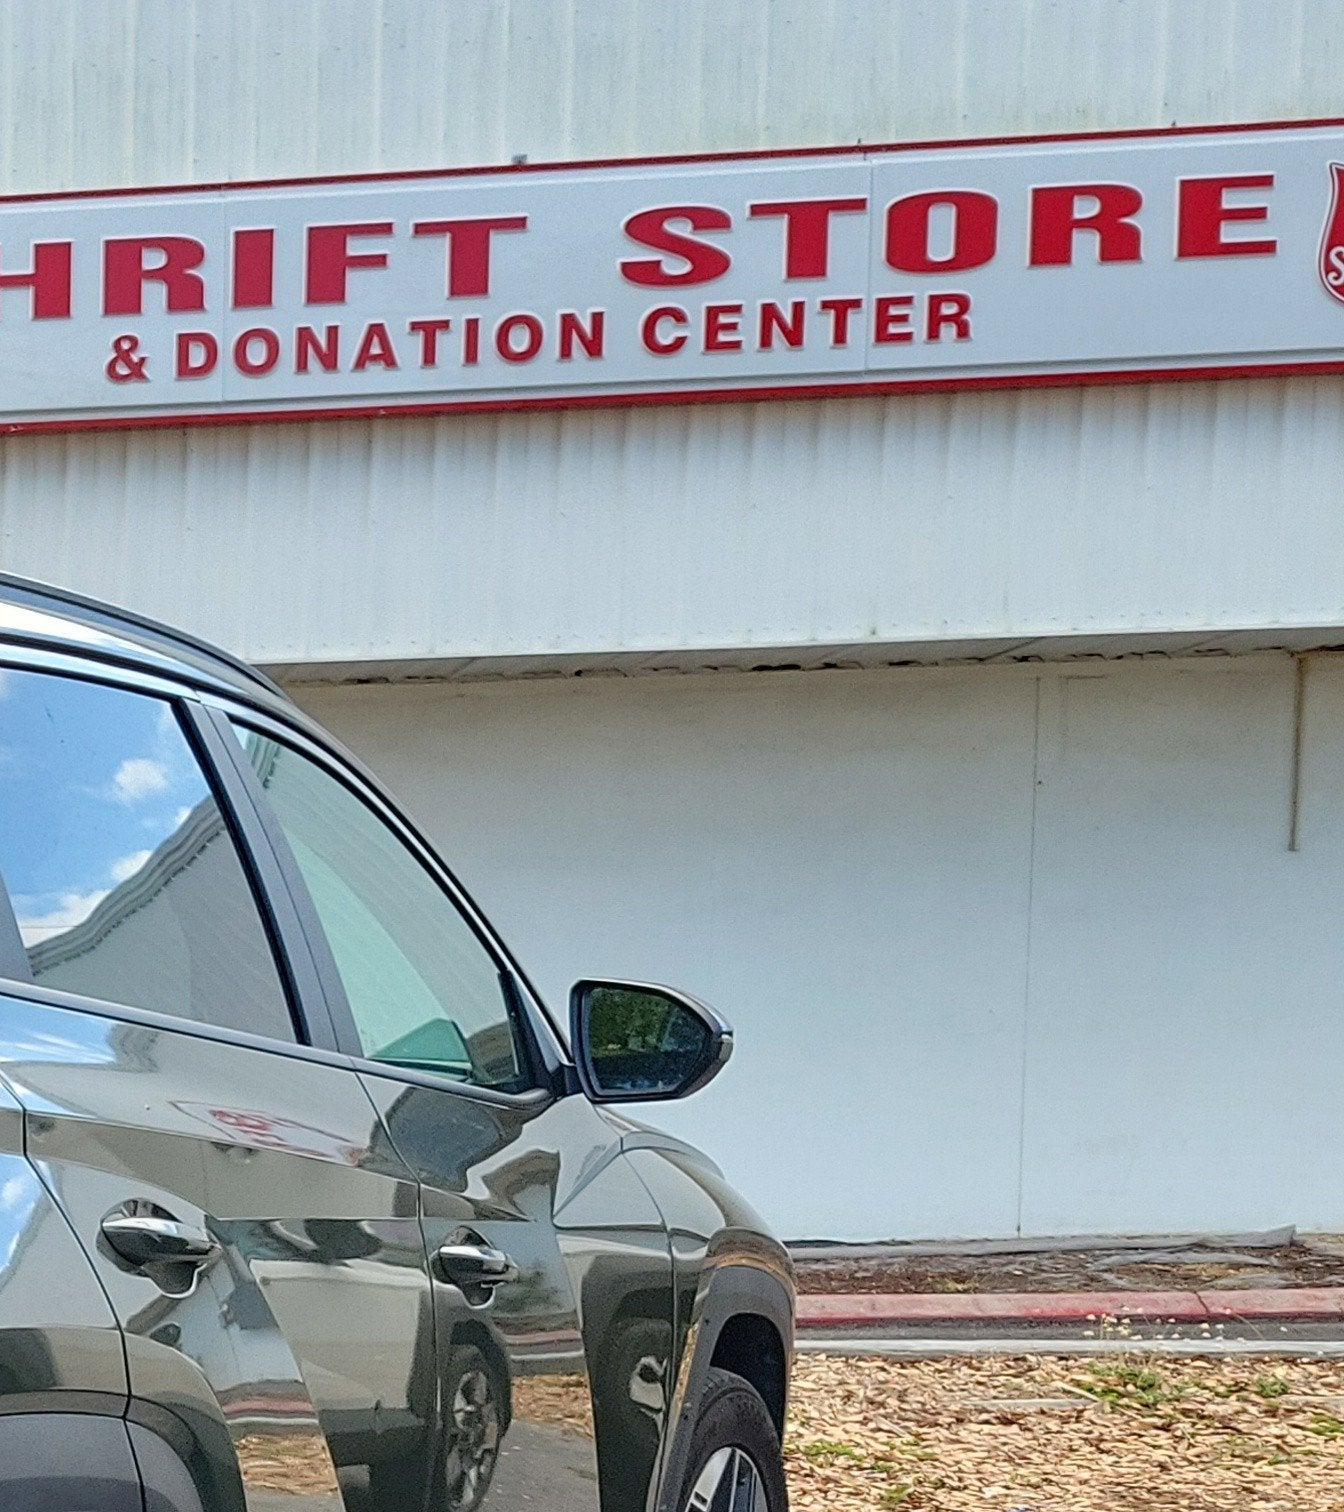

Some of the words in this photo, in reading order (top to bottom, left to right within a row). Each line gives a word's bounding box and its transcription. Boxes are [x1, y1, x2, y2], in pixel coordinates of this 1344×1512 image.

[619, 174, 1279, 288] STORE
[105, 333, 150, 383] &
[174, 311, 605, 381] DONATION
[641, 294, 972, 356] CENTER
